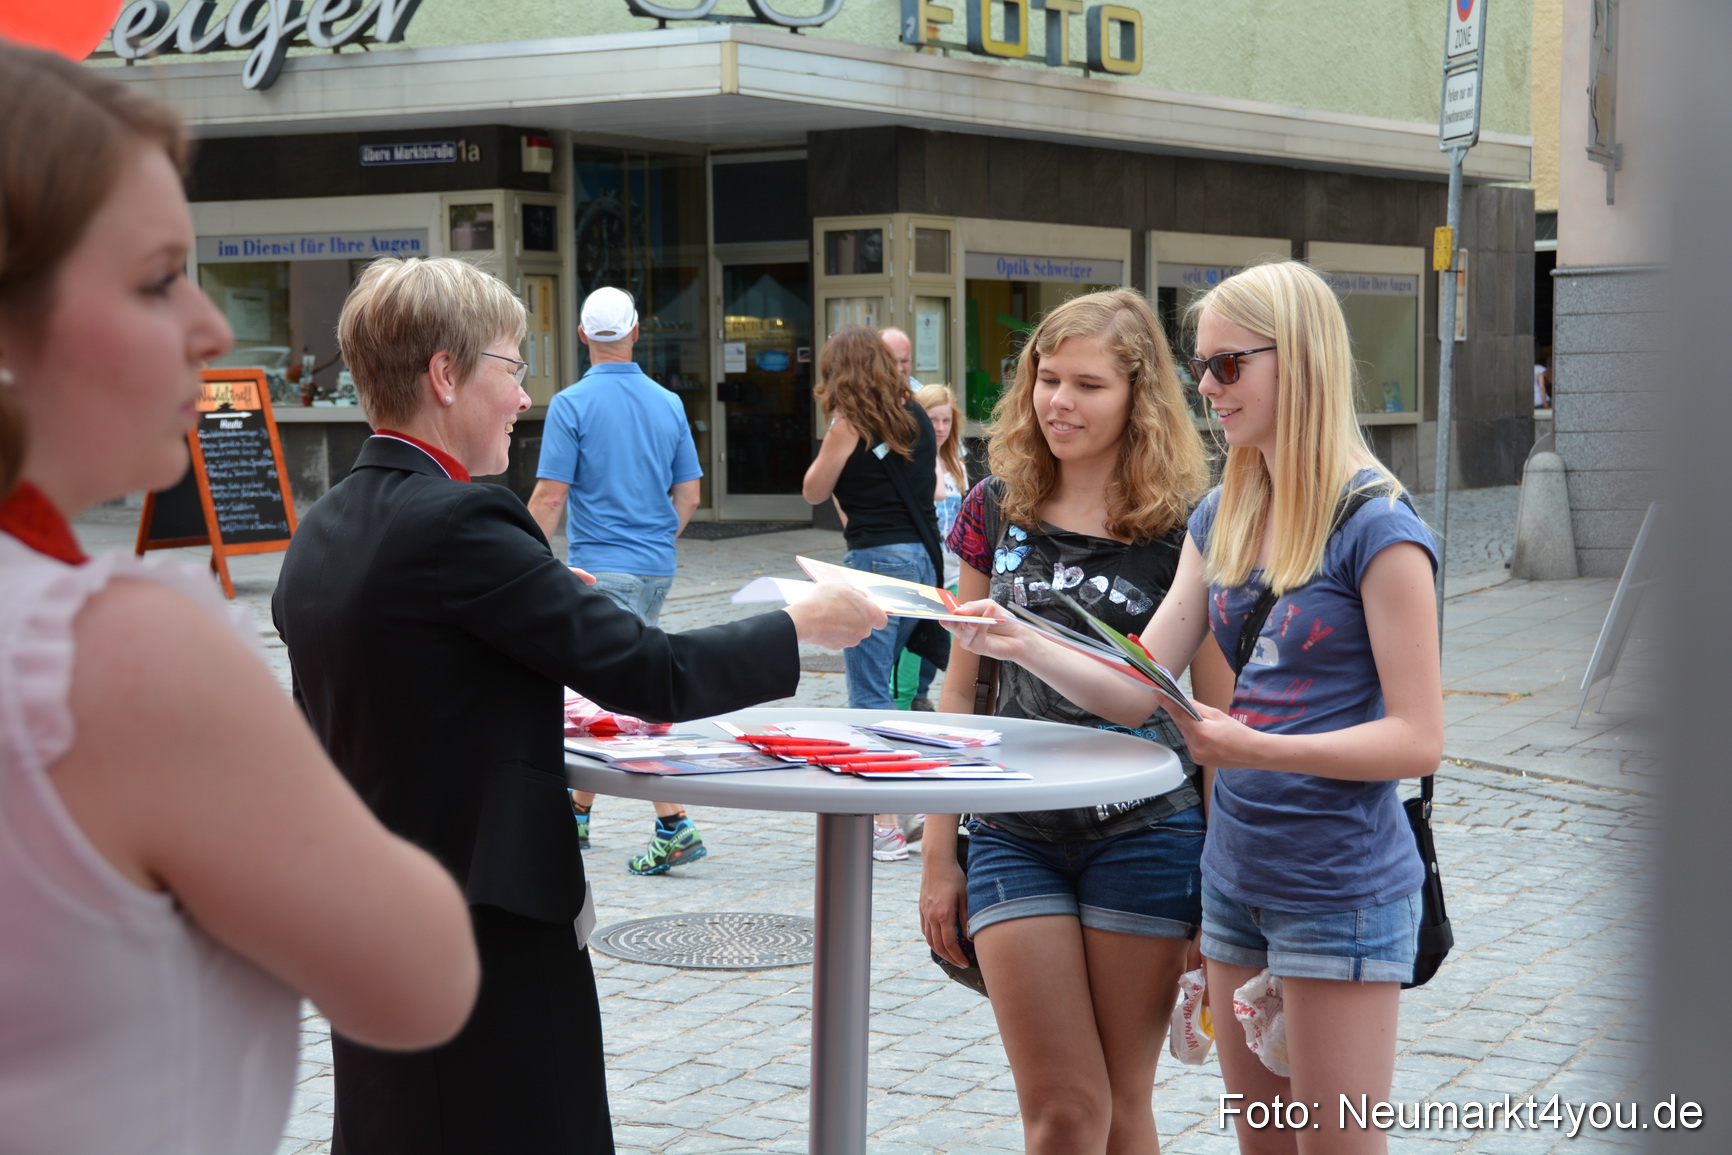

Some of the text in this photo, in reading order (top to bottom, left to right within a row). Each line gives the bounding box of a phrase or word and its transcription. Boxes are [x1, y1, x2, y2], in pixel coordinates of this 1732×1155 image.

[106, 0, 420, 91] eiger
[902, 0, 1143, 75] FOTO
[1455, 25, 1472, 49] ZONE
[393, 143, 455, 161] Marktstraße
[458, 139, 480, 162] 1a
[218, 236, 420, 257] im Dienst für Ihre Augen
[996, 257, 1092, 283] Optik Schweiger
[1182, 267, 1201, 283] seit
[1358, 276, 1370, 290] für
[1371, 277, 1388, 291] Ihre
[1390, 278, 1412, 295] Augen
